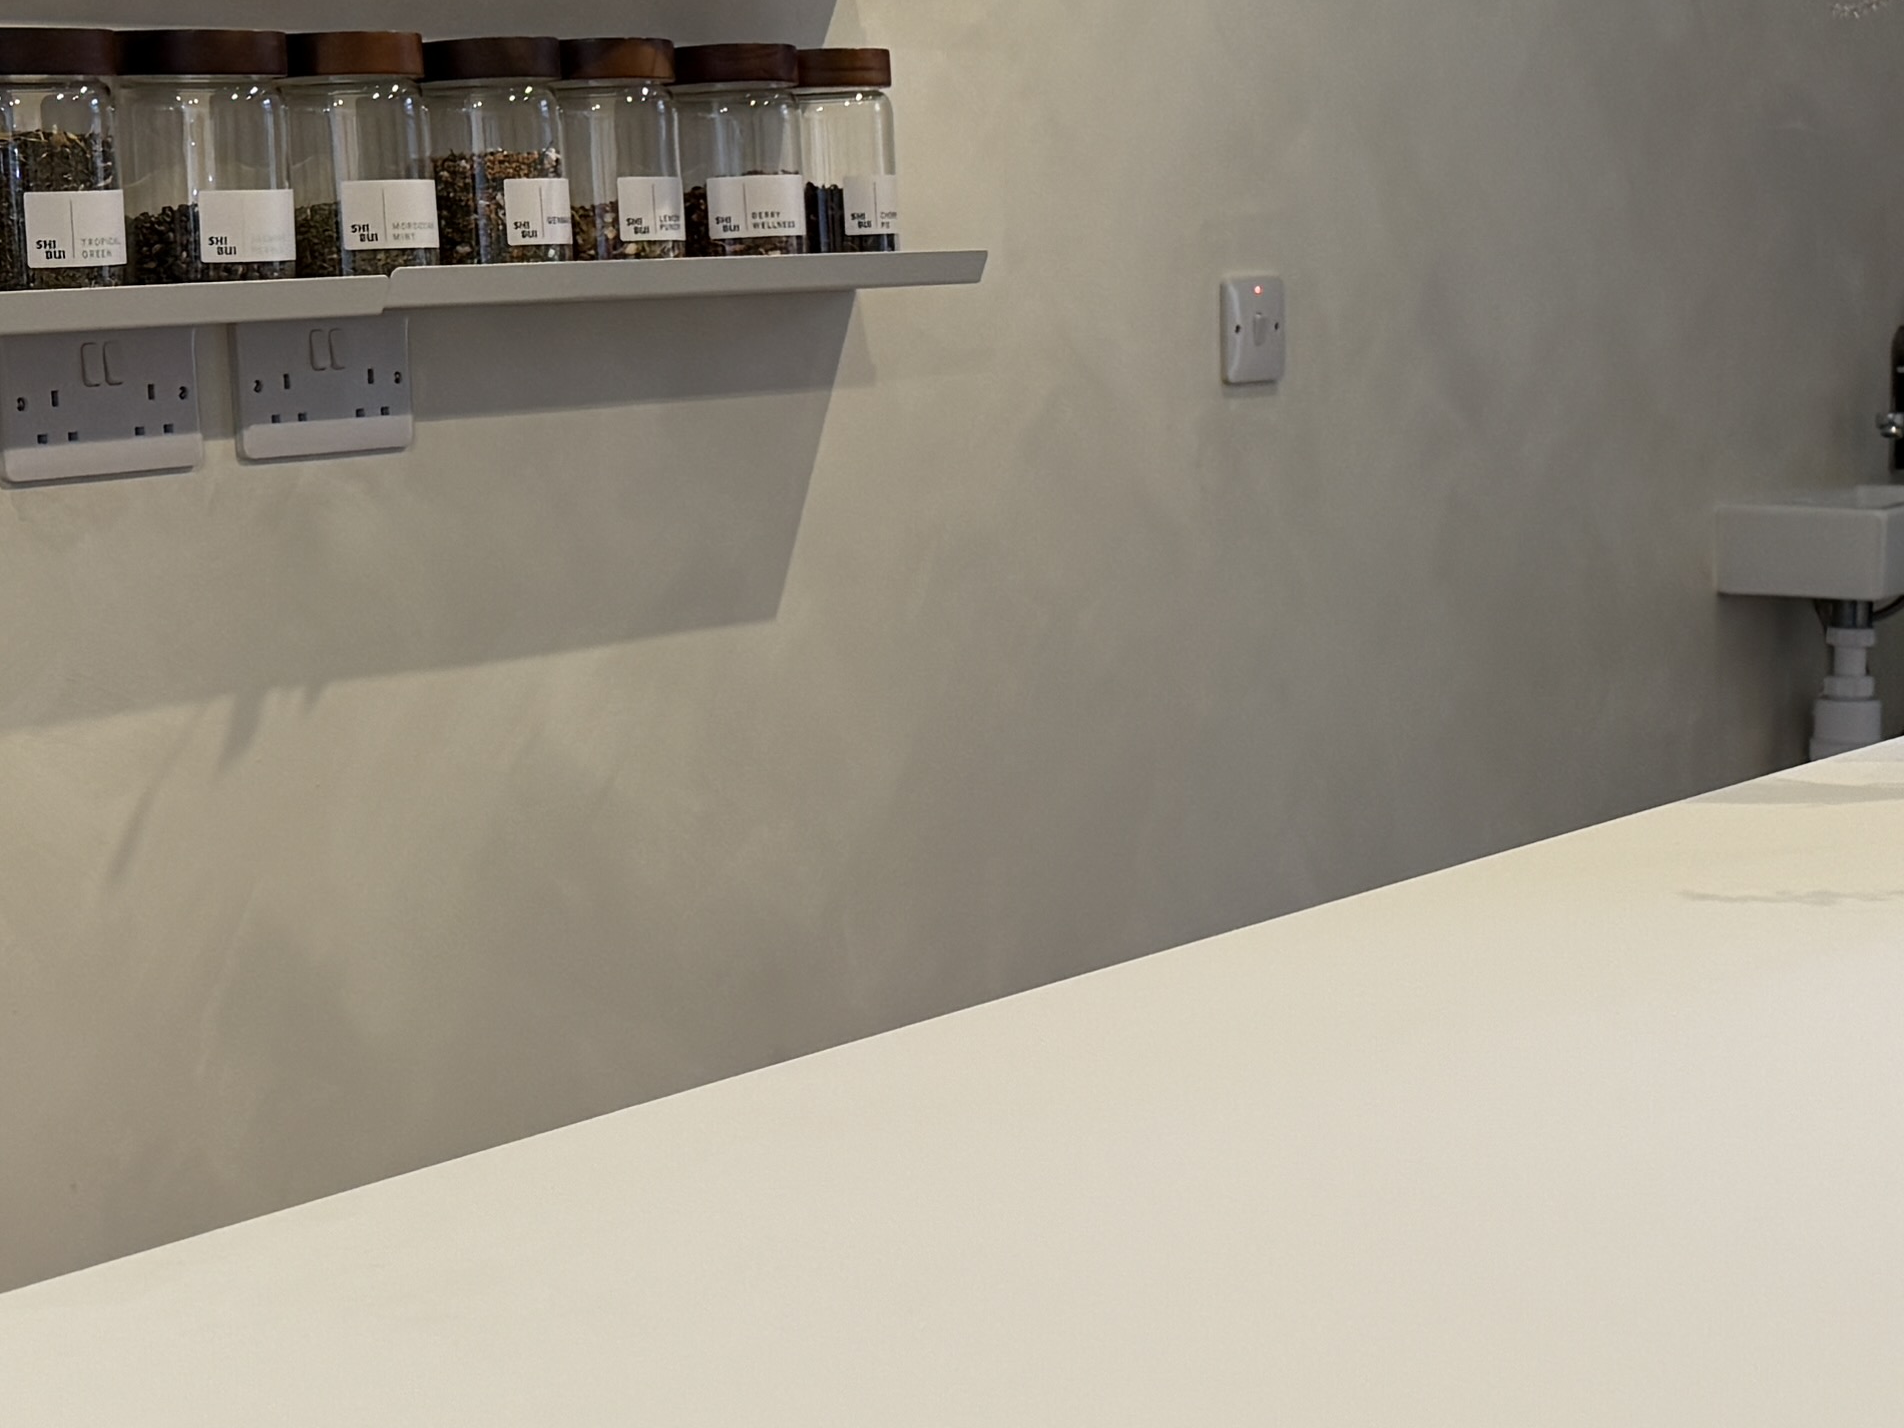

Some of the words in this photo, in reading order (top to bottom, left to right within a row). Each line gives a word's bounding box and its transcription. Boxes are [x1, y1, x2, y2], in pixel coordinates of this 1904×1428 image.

[350, 223, 370, 233] SHI
[208, 236, 227, 246] SHI
[359, 233, 379, 243] BUI
[35, 239, 57, 250] SHI
[44, 250, 66, 260] BUI
[216, 246, 237, 256] BUI
